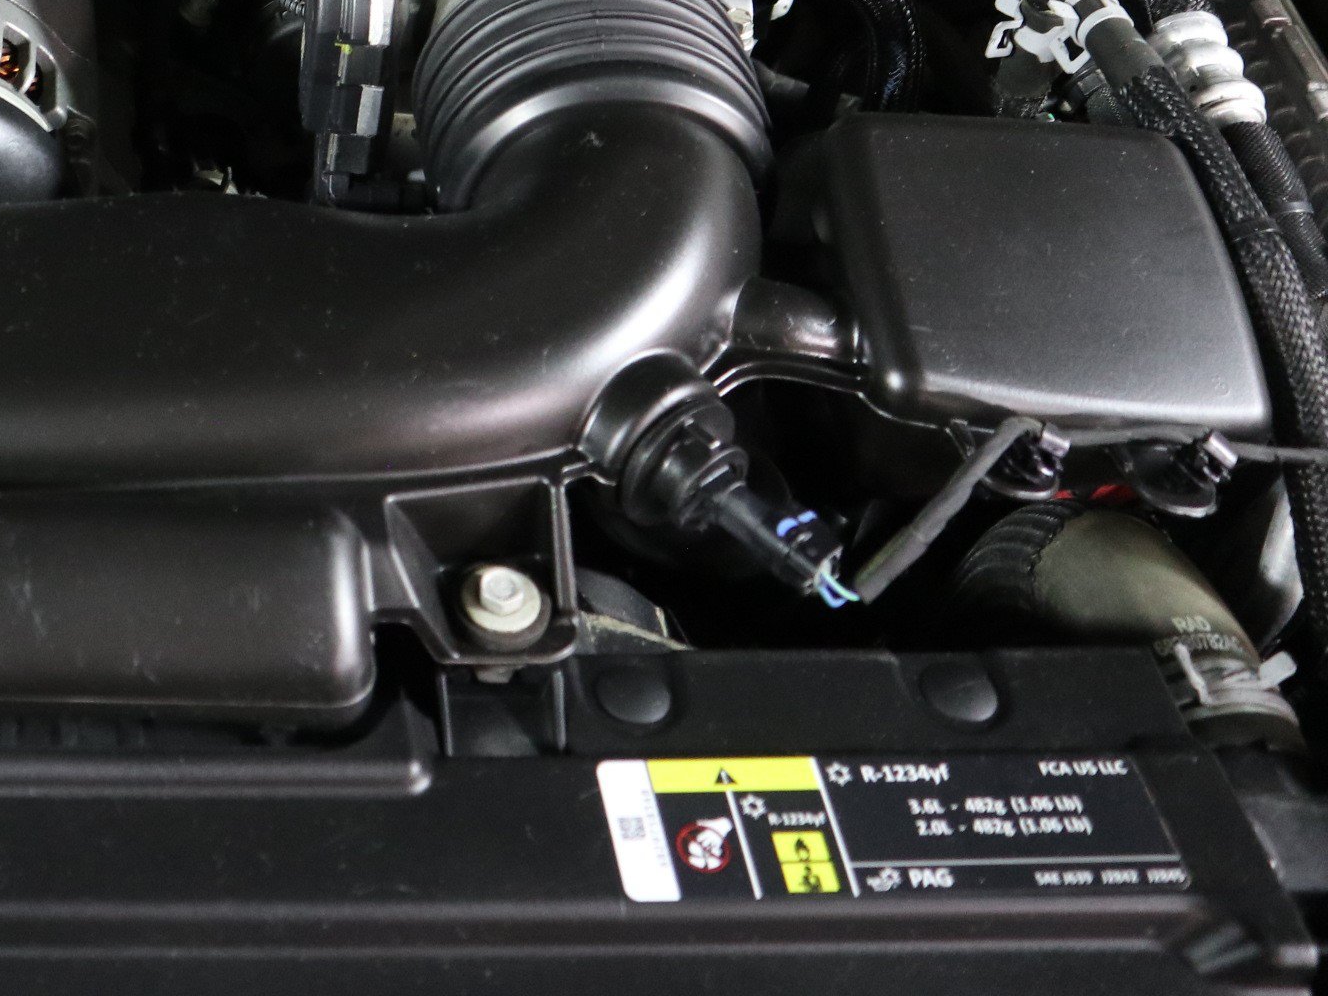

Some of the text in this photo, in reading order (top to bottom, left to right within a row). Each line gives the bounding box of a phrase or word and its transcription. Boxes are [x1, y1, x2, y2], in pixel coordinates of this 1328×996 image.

[1171, 614, 1212, 634] RAD
[859, 763, 950, 786] R-1234yf
[1038, 759, 1129, 777] FCA US LLC
[907, 798, 945, 815] 3.6L
[908, 867, 956, 889] PAG
